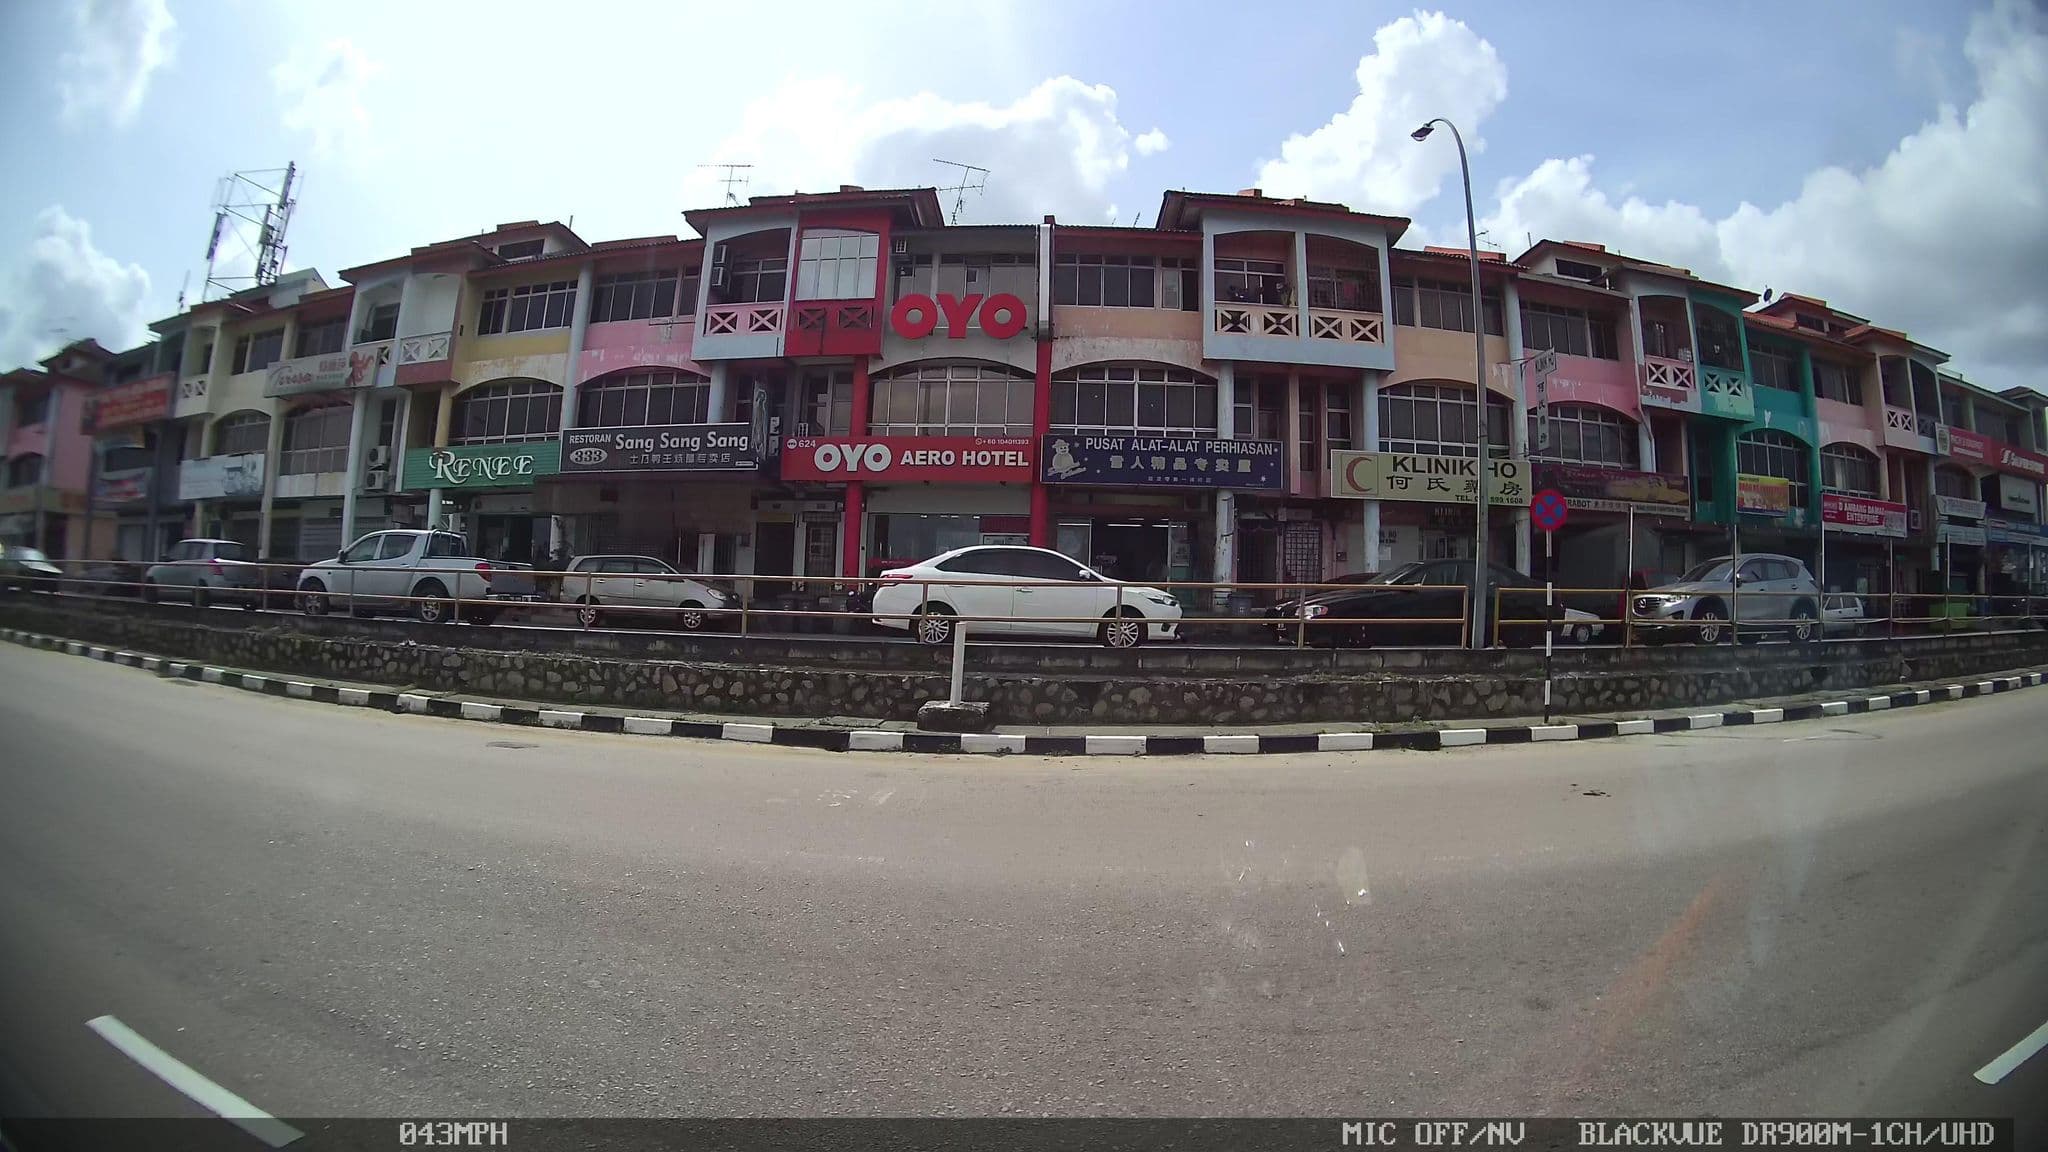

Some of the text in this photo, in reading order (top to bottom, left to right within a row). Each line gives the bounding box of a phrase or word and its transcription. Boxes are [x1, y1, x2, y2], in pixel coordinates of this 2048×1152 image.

[891, 293, 1027, 339] OYO
[569, 434, 611, 444] RESTORAN
[615, 433, 654, 452] Sang
[660, 432, 700, 451] Sang
[707, 431, 749, 451] Sang
[798, 439, 816, 448] 624
[1085, 438, 1273, 455] PUSAT ALAT-ALAT PERHIASAN
[574, 450, 600, 462] 333
[814, 443, 1029, 472] OYO AERO HOTEL
[428, 451, 534, 484] RENEE
[1392, 455, 1517, 479] KLINIK HO
